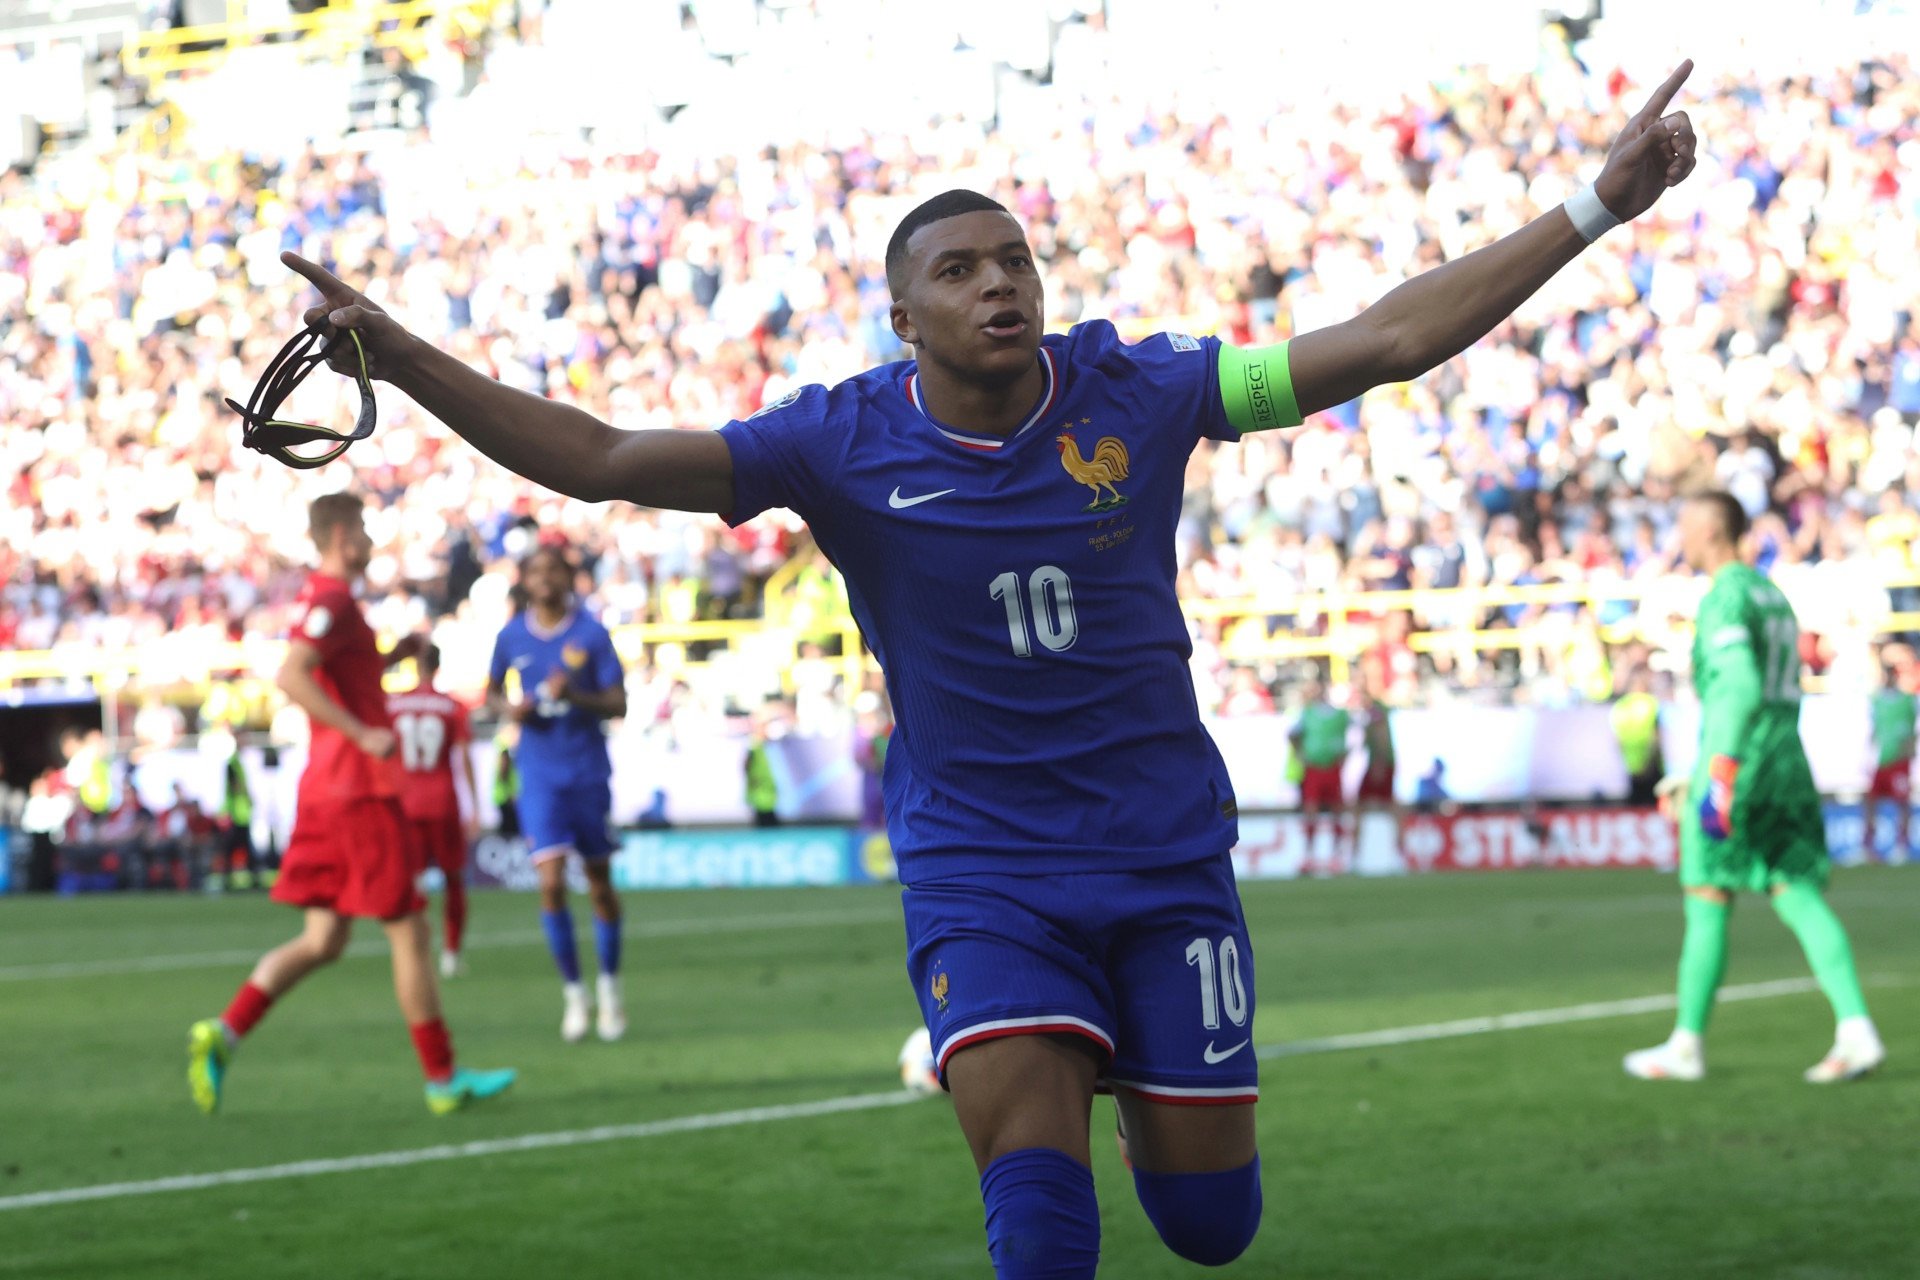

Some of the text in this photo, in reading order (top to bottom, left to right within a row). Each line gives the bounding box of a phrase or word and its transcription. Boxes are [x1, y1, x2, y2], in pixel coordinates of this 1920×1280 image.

[1249, 363, 1272, 422] RESPECT
[989, 565, 1078, 658] 10
[393, 714, 446, 772] 19
[1450, 811, 1673, 867] STRAUSS
[1185, 935, 1247, 1030] 10
